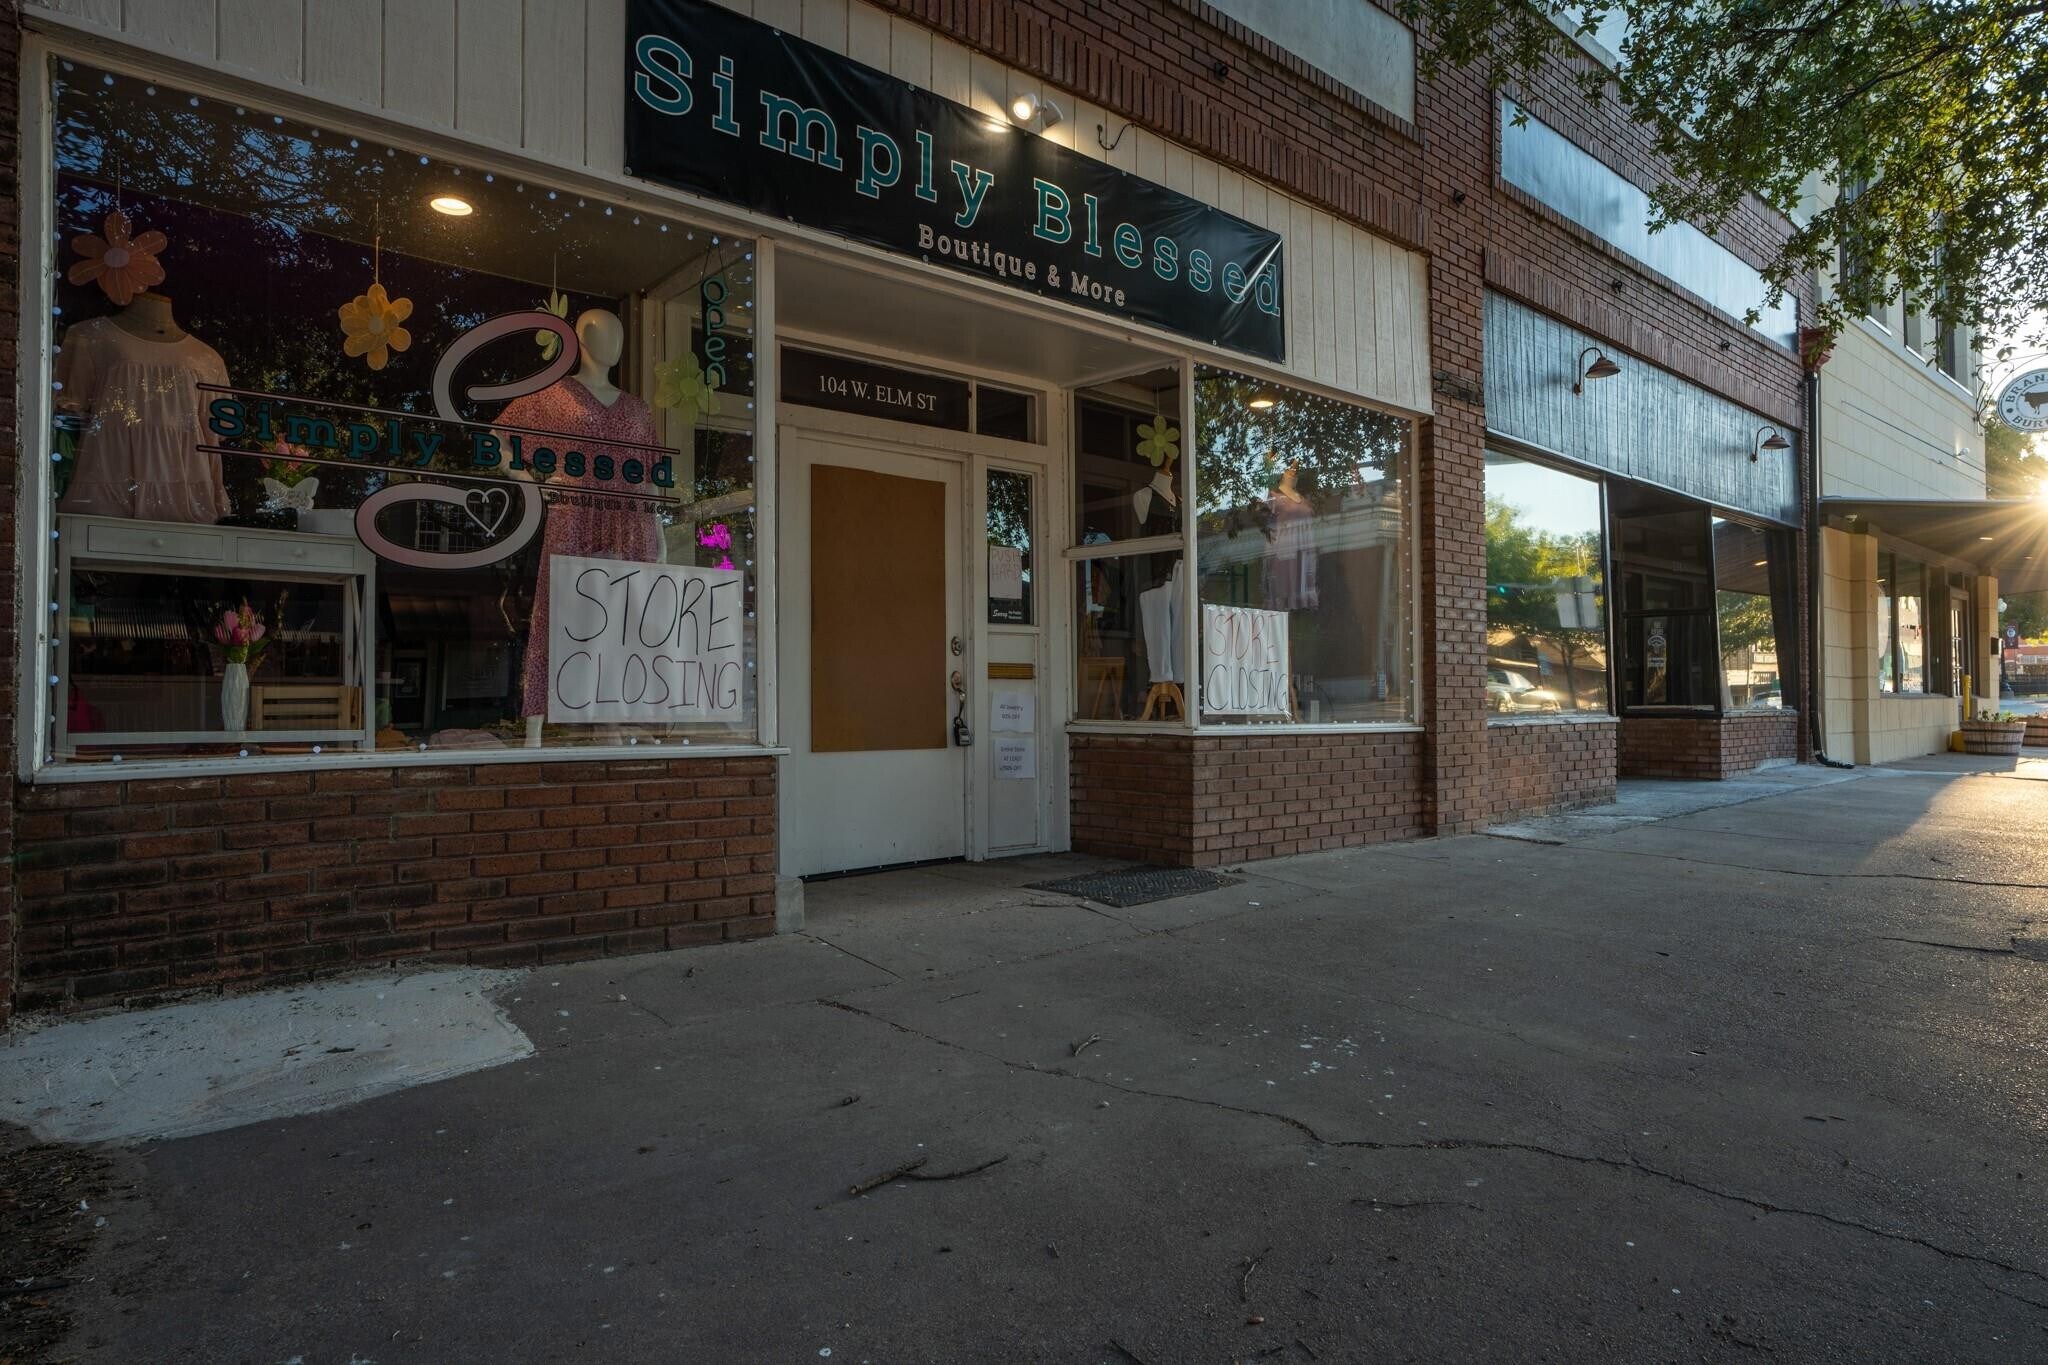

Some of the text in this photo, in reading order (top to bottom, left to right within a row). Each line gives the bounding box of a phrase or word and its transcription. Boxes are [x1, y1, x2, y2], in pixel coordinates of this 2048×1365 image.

[634, 34, 1281, 317] Simply Blessed
[918, 223, 1126, 307] Boutique & More
[819, 375, 937, 411] 104 W. ELM ST
[2005, 374, 2048, 402] BRAN
[209, 398, 675, 488] Simply Blessed
[565, 568, 739, 655] STORE
[1210, 612, 1282, 666] STORE
[556, 651, 741, 710] CLOSING
[1206, 663, 1288, 711] CLOSING
